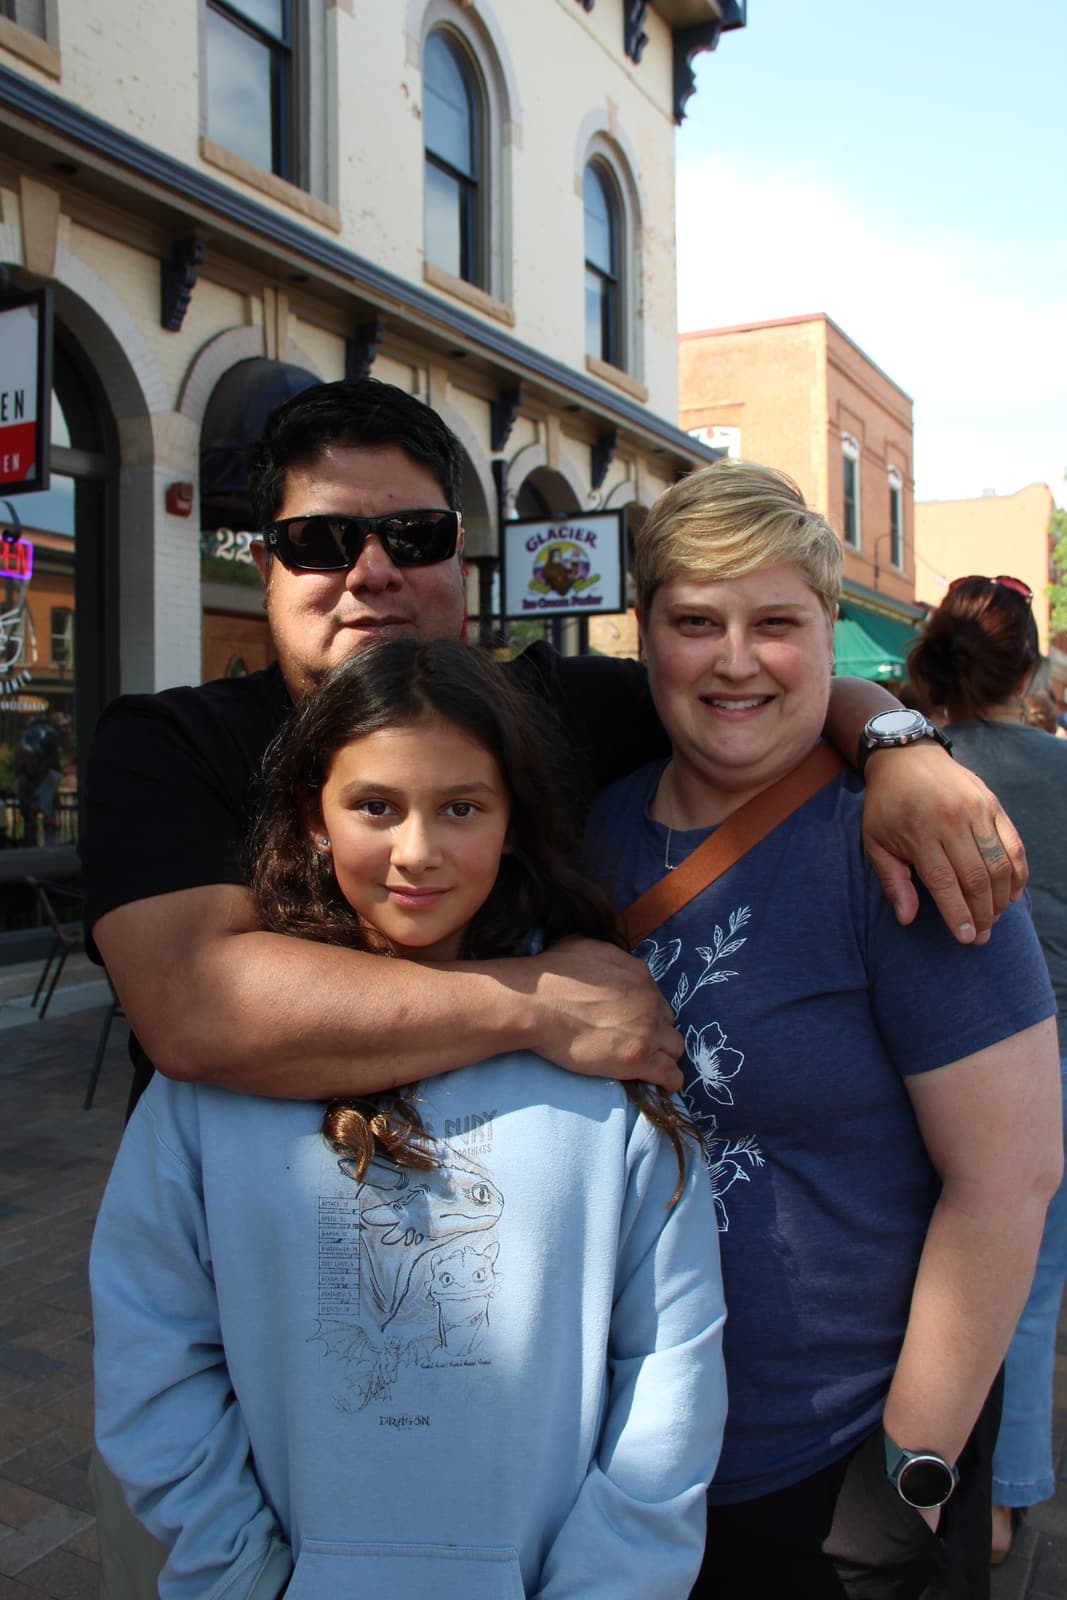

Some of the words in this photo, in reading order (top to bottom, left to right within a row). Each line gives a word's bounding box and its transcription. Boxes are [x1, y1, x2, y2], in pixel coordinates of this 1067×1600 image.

[215, 527, 264, 564] 22
[525, 525, 598, 553] GLACIER
[378, 1415, 431, 1427] DRAGON
